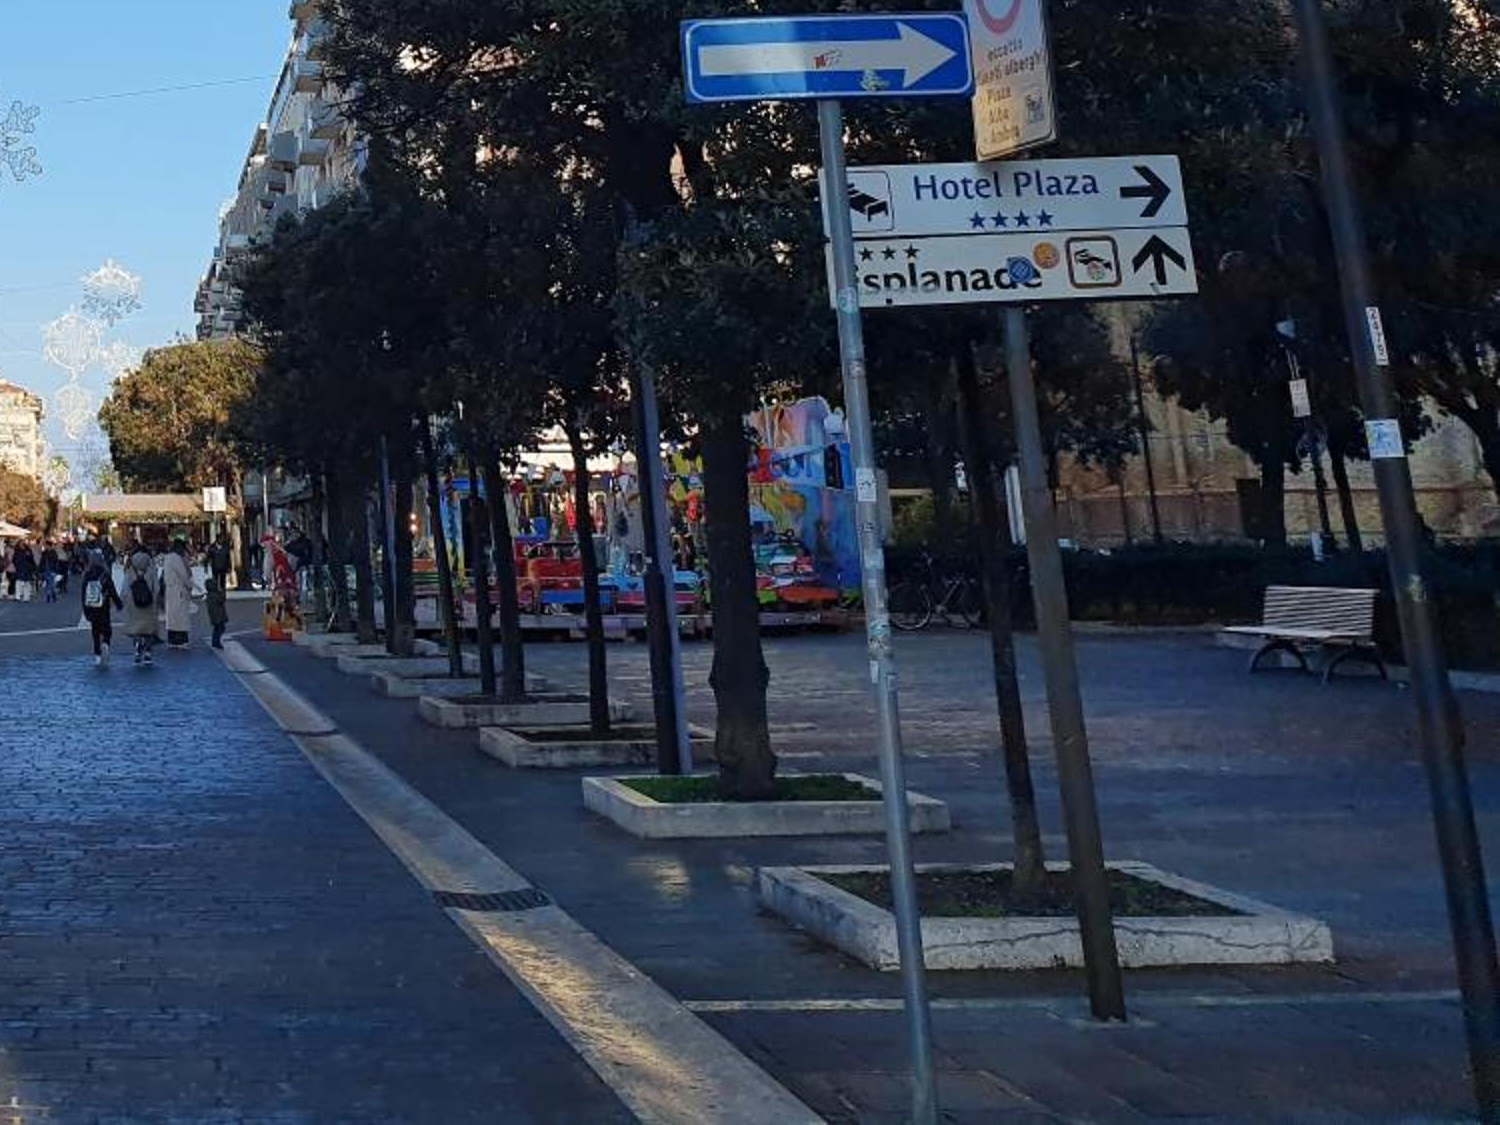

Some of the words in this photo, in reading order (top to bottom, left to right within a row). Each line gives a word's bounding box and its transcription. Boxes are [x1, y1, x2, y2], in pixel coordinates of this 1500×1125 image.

[914, 171, 1002, 201] Hotel
[1013, 169, 1100, 197] Plaza
[854, 256, 1043, 304] splanade
